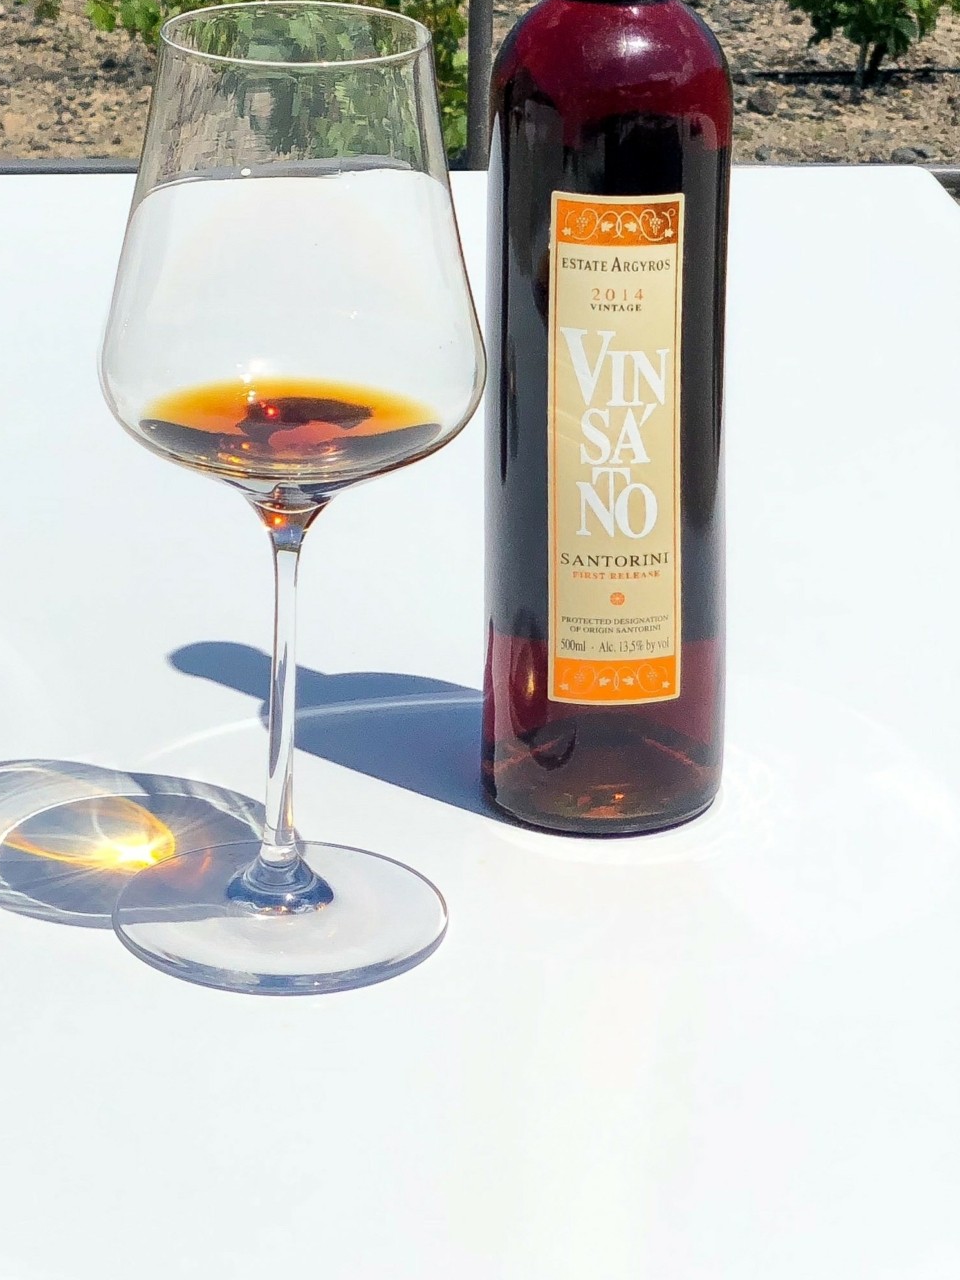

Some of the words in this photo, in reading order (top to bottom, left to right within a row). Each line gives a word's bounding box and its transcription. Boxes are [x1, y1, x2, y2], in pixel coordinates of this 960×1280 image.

[562, 257, 608, 272] ESTATE
[611, 256, 671, 272] ARGYROS
[591, 288, 644, 301] 2014
[590, 303, 642, 312] VINTAGE
[560, 552, 670, 568] SANTORINI
[572, 570, 606, 580] FIRST
[610, 570, 661, 580] RELEASE
[561, 615, 612, 625] PROTECTED
[613, 614, 669, 625] DESIGNATION
[569, 625, 581, 633] OF
[582, 626, 614, 634] ORIGIN
[615, 624, 661, 634] SANTORINI
[560, 638, 586, 652] 500ml
[598, 640, 617, 653] Alc.
[646, 639, 656, 653] by
[657, 636, 670, 648] vol
